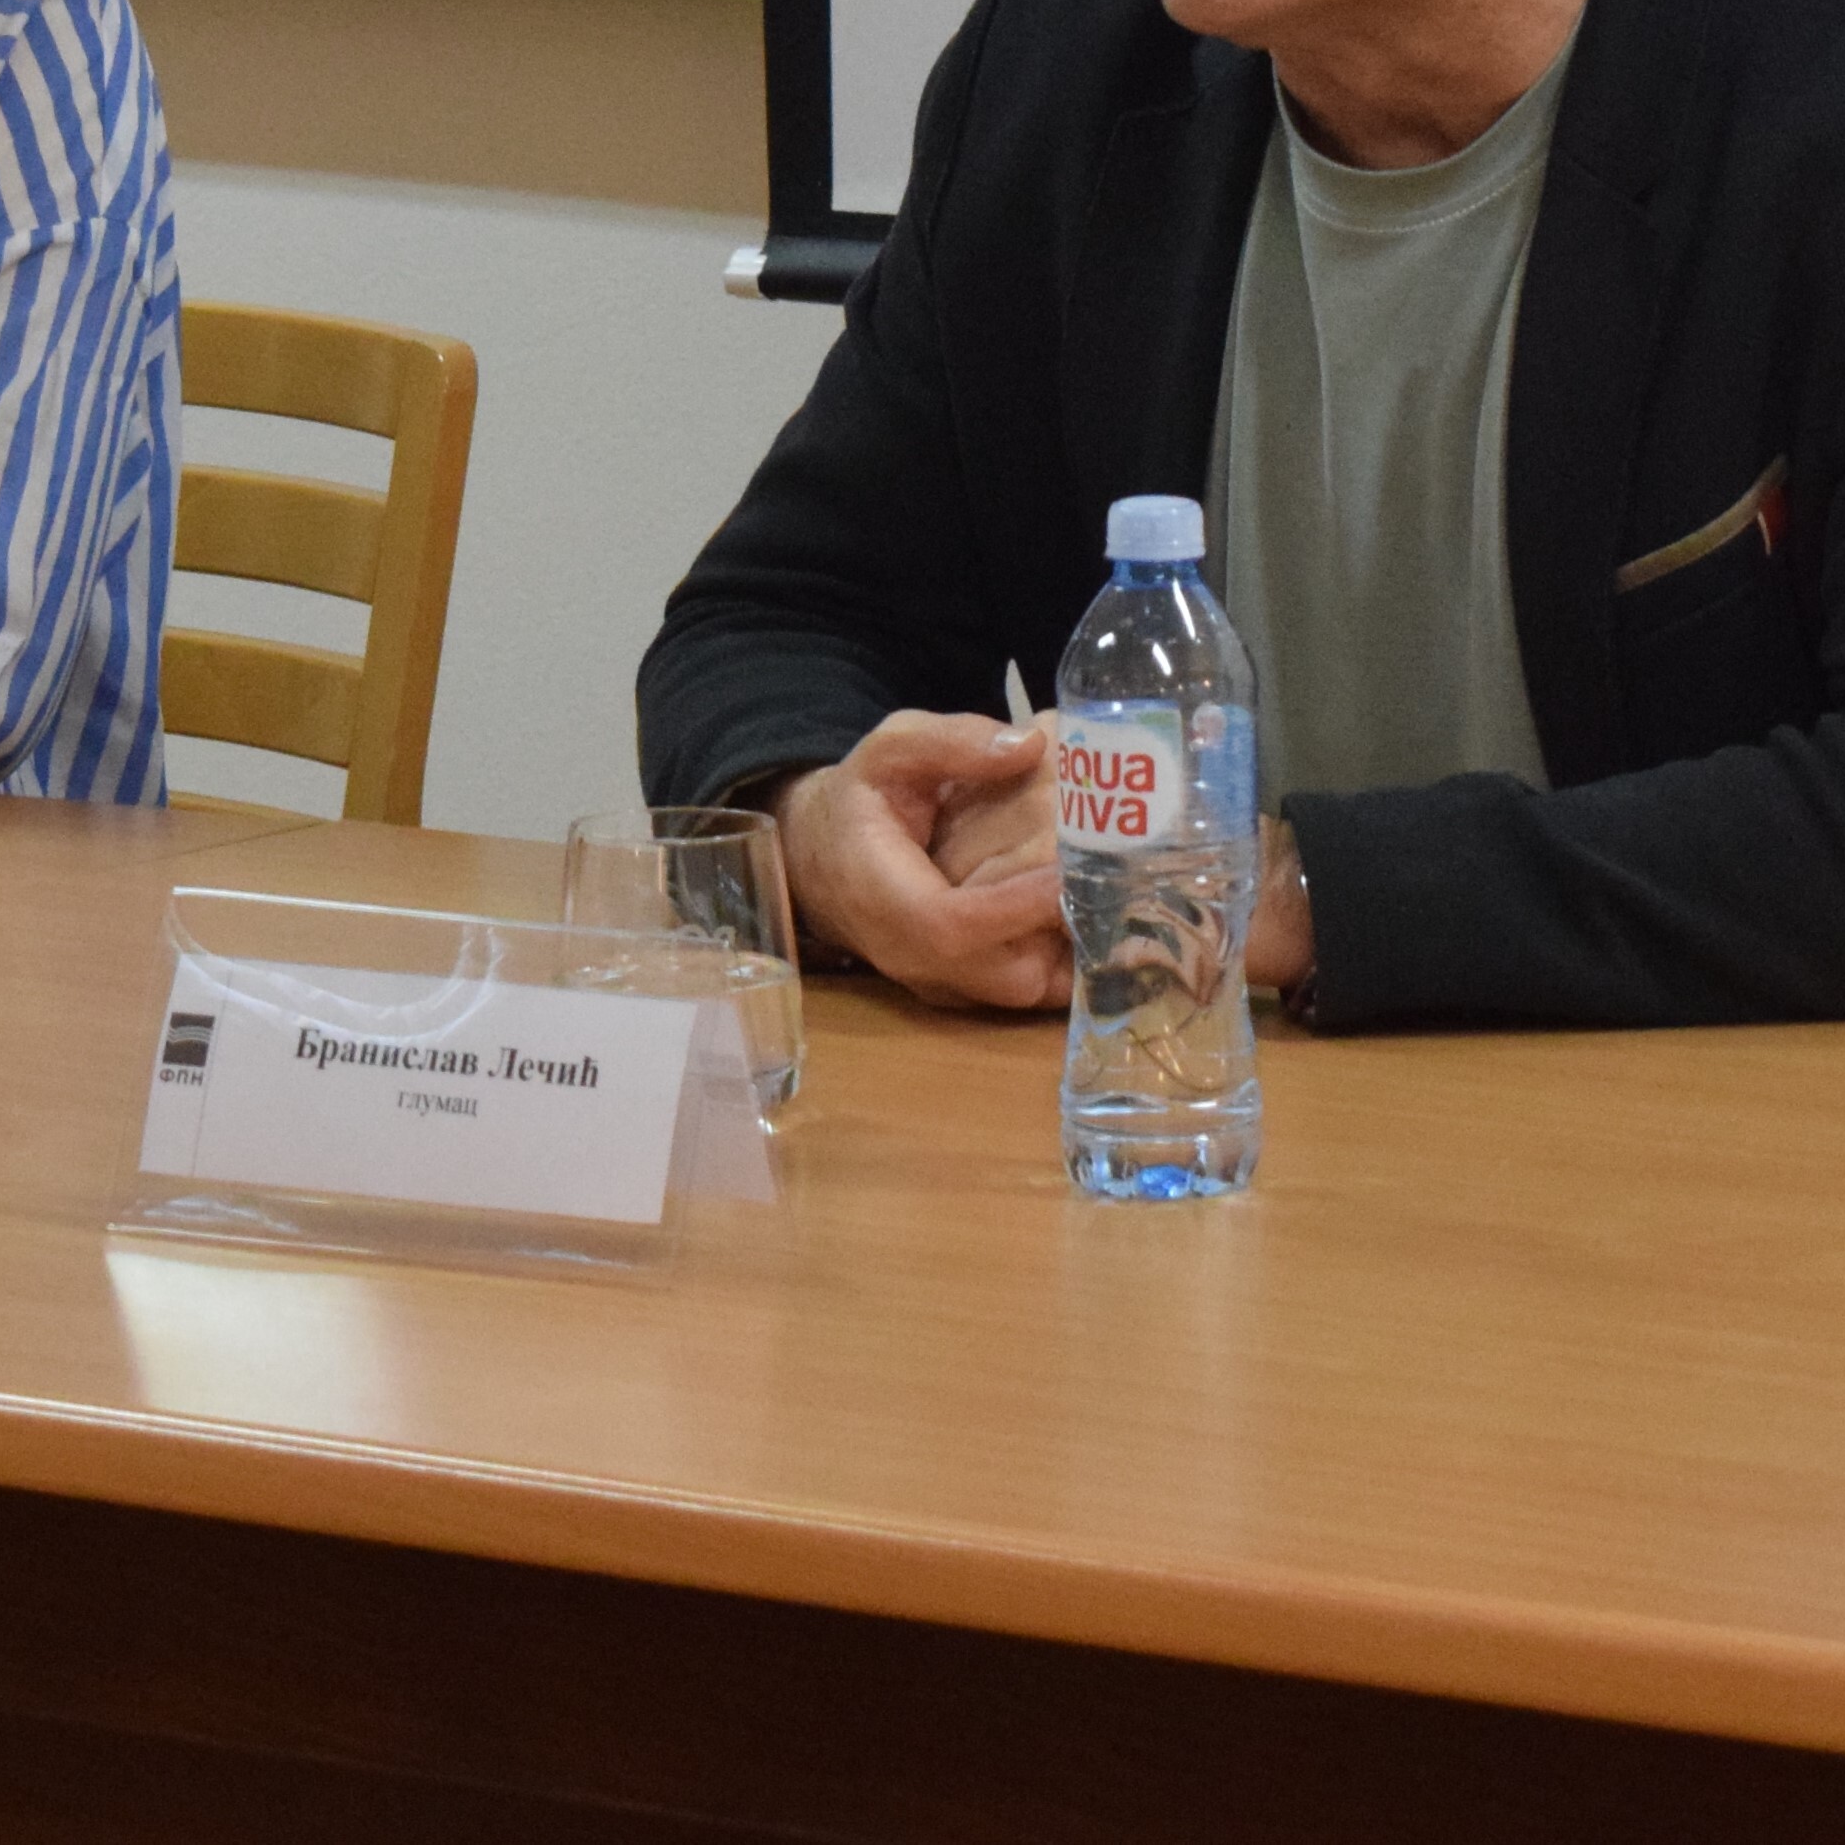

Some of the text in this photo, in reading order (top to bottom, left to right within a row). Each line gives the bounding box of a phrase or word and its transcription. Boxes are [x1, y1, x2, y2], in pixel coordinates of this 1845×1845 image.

[294, 1027, 600, 1089] Бранислав Лечић
[158, 1067, 205, 1087] ФПН
[397, 1088, 480, 1118] глумац
